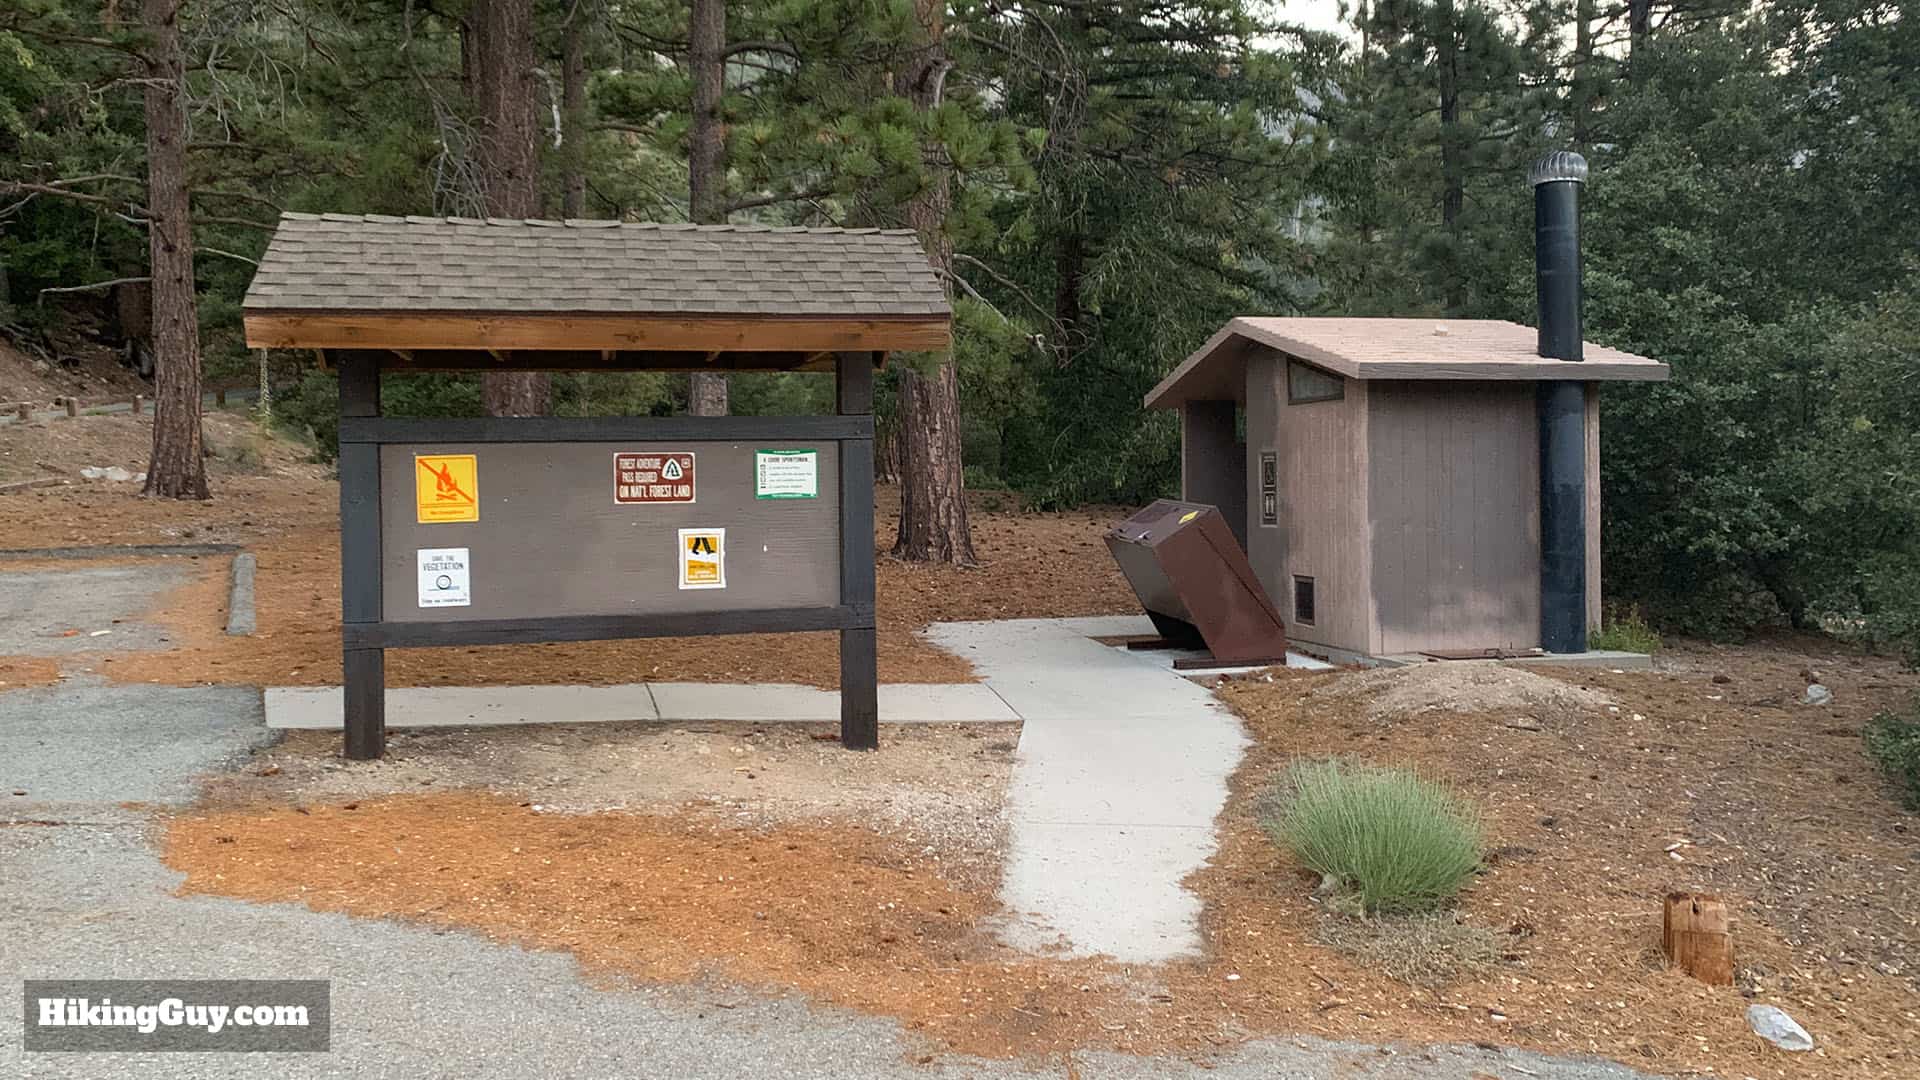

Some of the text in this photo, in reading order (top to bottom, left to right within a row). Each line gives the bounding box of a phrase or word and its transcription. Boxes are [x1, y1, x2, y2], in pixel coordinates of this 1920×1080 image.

[619, 458, 661, 469] FOREST ADVENTURE
[622, 471, 657, 482] PASS REQUIRED
[619, 484, 629, 498] ON
[649, 484, 672, 497] FOREST
[673, 484, 690, 497] LAND
[423, 562, 464, 571] VEGETATION
